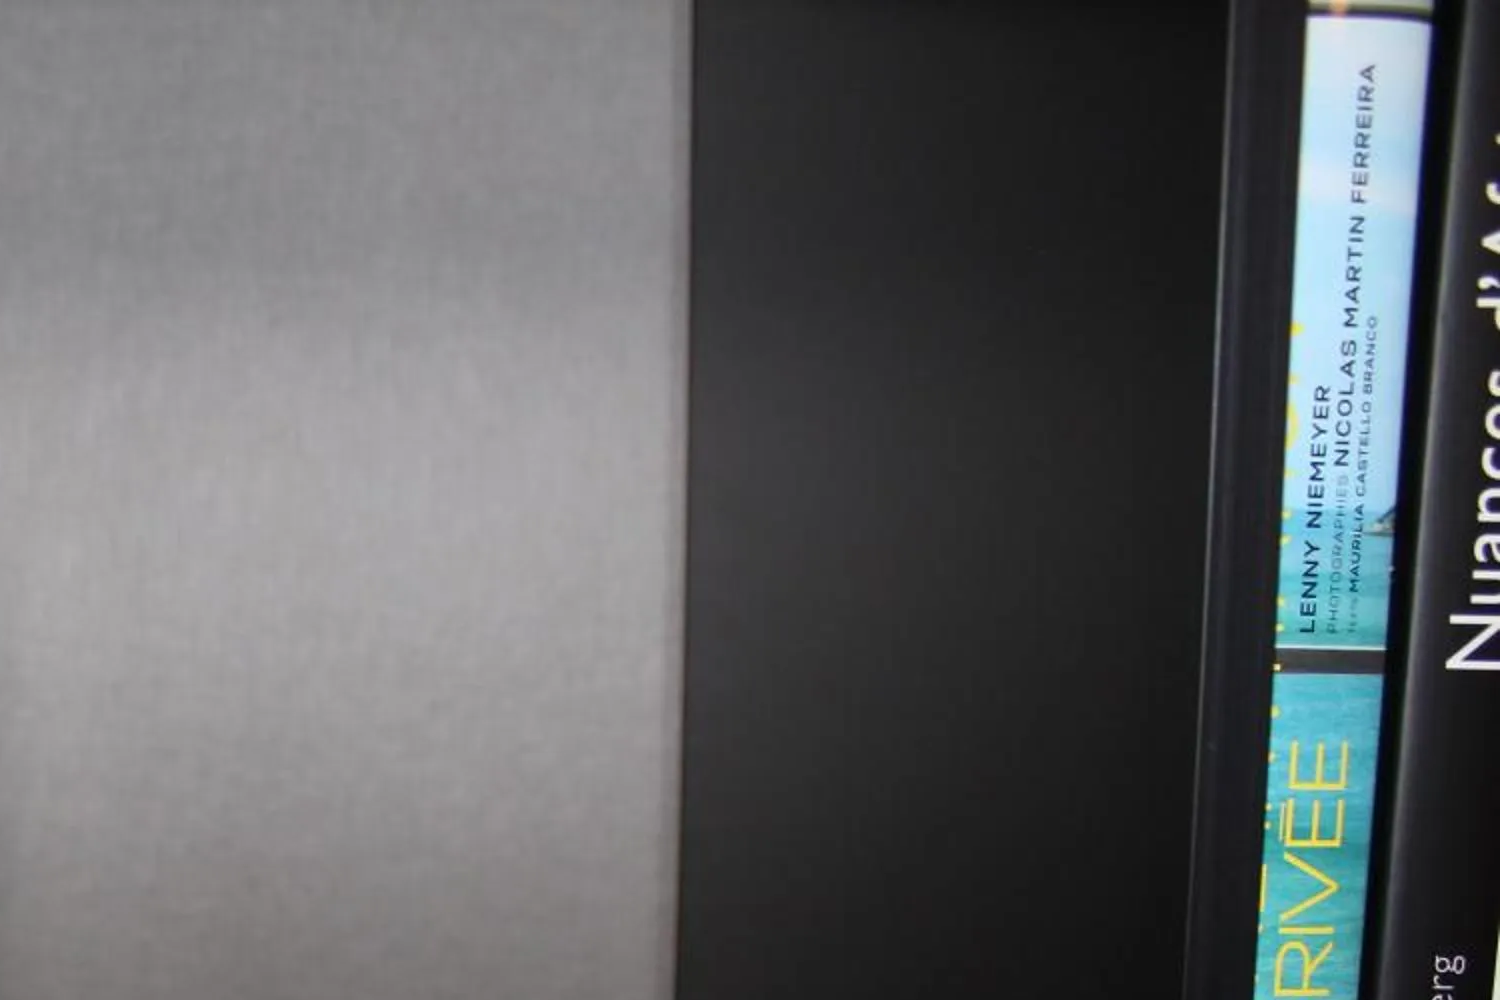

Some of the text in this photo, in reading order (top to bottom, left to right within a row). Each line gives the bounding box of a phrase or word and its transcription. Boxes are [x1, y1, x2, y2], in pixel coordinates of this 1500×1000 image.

[1327, 64, 1376, 635] PHOTOGRAPHIES NICOLAS MARTIN FERREIRA
[1363, 316, 1378, 395] BRANCO
[1356, 400, 1373, 497] CASTELLO
[1299, 385, 1332, 634] LENNY NIEMEYER
[1349, 503, 1365, 593] MAURILIA
